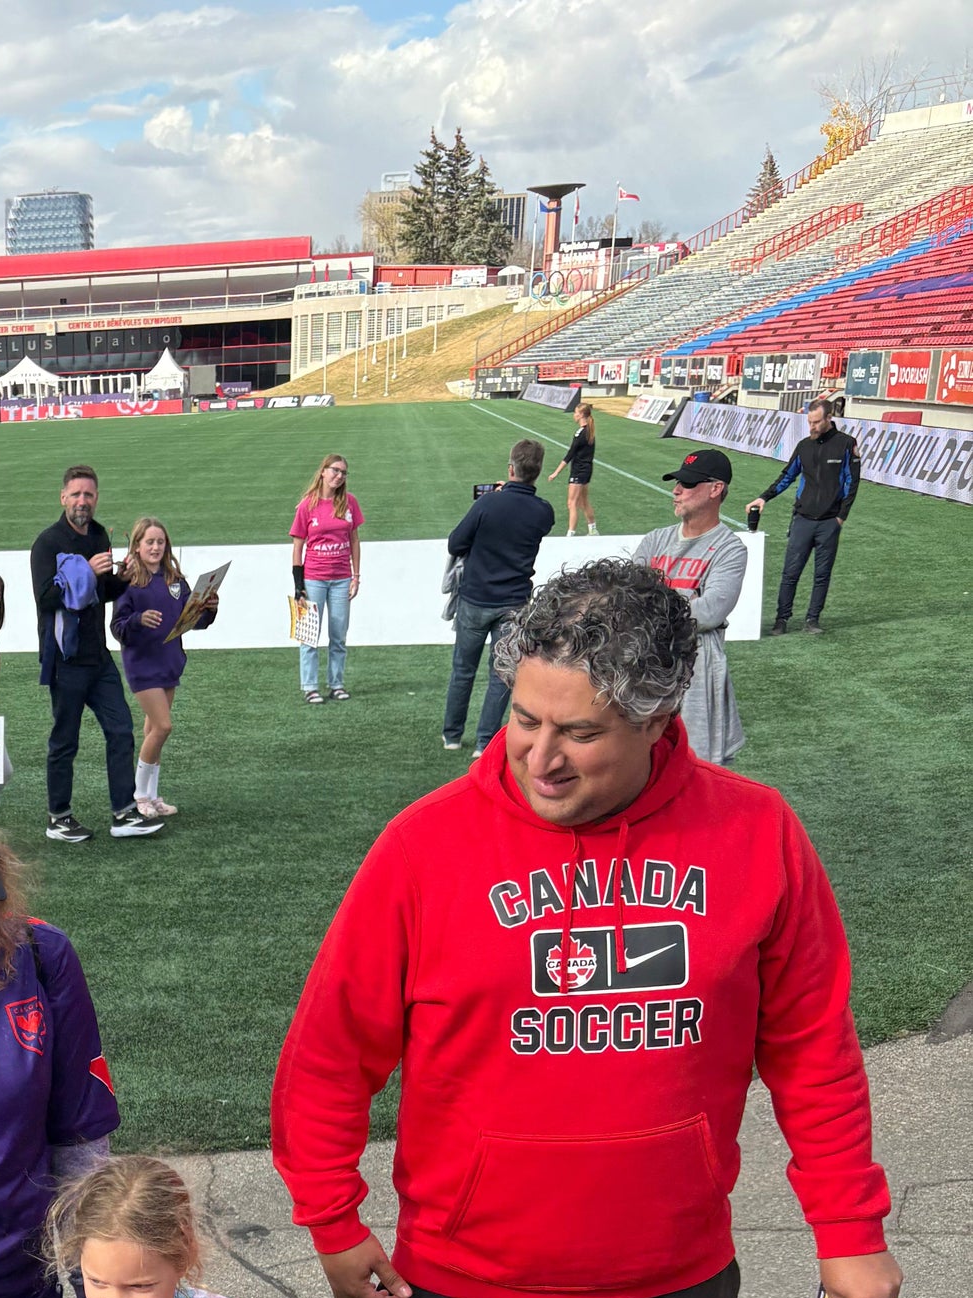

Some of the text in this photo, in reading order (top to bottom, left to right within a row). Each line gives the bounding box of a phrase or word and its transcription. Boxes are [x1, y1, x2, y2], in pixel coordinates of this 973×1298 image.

[11, 324, 35, 333] CENTRE
[68, 321, 92, 329] CENTRE
[93, 320, 106, 328] DES
[142, 316, 183, 326] OLYMPIQUES
[94, 334, 171, 348] Patio
[488, 858, 706, 928] CANADA
[546, 957, 596, 969] CANADA
[510, 997, 704, 1055] SOCCER
